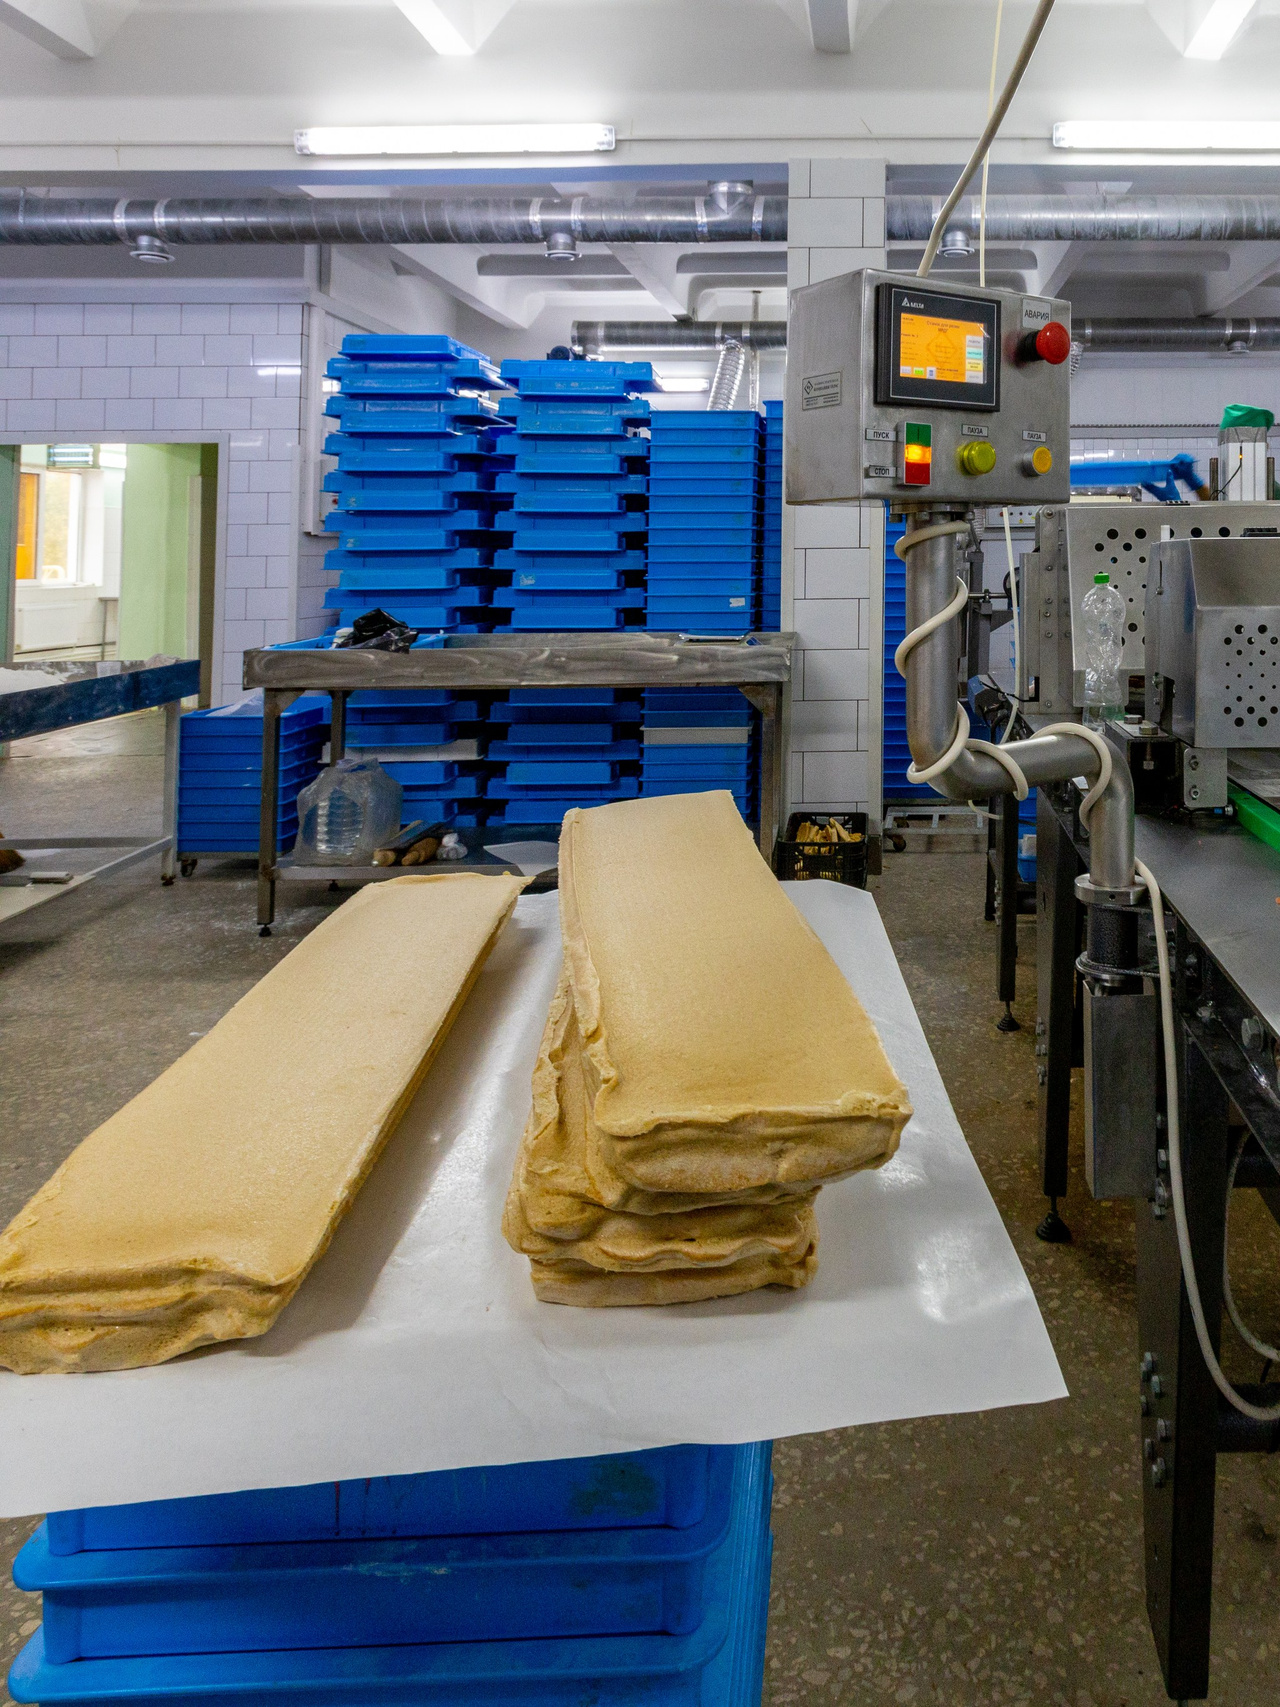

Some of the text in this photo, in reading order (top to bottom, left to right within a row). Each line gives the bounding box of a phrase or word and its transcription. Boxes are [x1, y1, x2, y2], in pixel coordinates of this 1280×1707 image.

[1024, 309, 1050, 321] АВАРИЯ
[873, 431, 890, 439] ПУСК
[967, 427, 983, 435] ПАУЗА
[1027, 432, 1042, 440] ПАУЗА
[874, 467, 890, 475] СТОП
